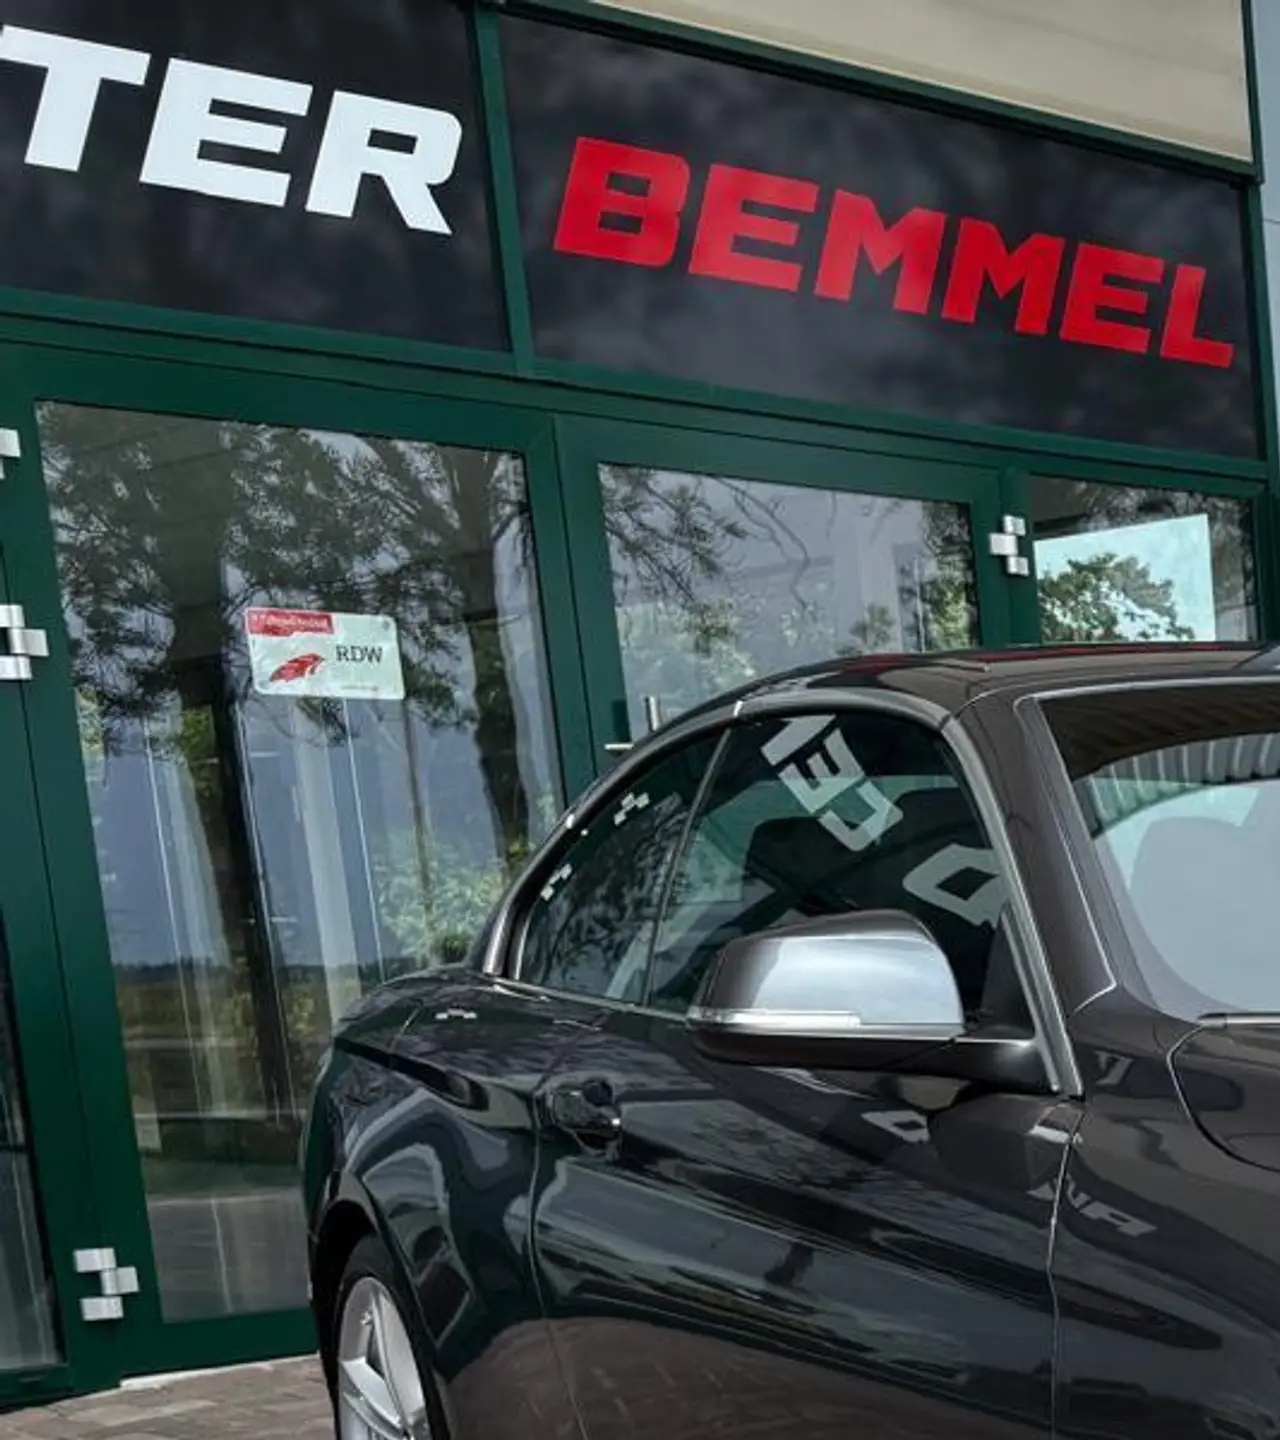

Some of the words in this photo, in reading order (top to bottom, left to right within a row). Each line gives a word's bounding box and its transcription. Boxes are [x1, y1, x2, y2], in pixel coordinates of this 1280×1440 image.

[0, 26, 463, 235] TER
[554, 136, 1235, 369] BEMMEL
[335, 645, 383, 664] RDW
